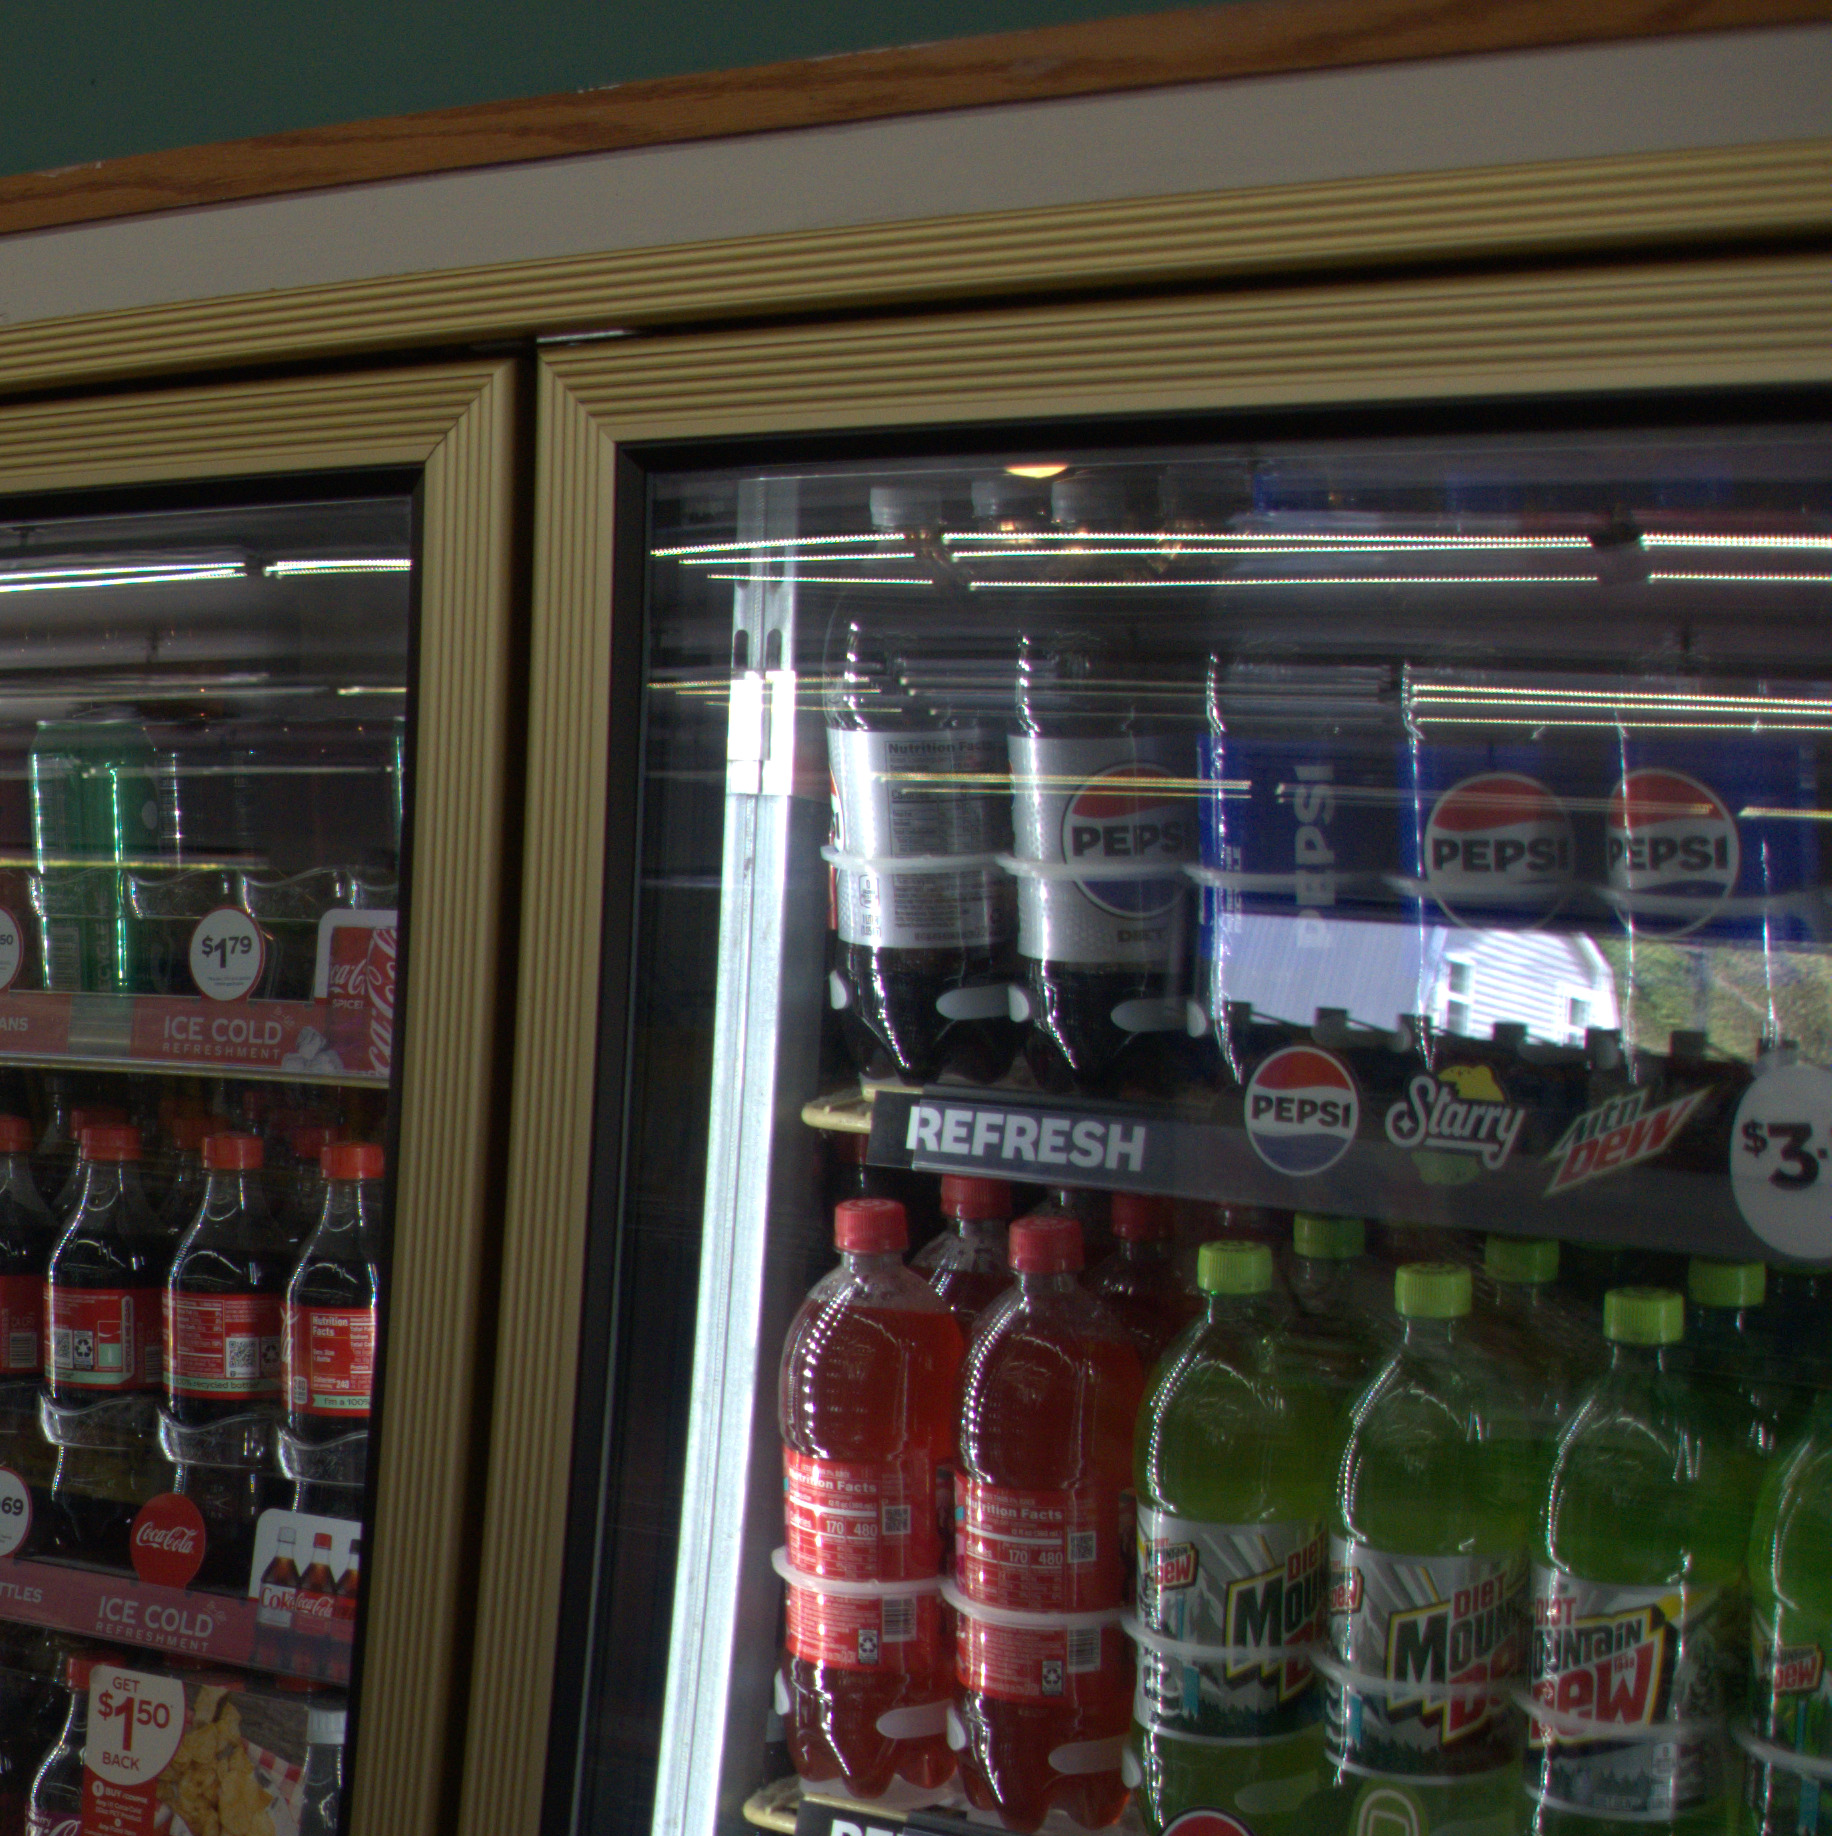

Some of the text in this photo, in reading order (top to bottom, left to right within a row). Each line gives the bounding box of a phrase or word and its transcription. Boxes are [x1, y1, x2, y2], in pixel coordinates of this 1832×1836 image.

[1433, 836, 1570, 872] PEPSI
[201, 935, 253, 969] $179
[163, 1015, 282, 1046] ICE COLD
[163, 1042, 280, 1060] REFRESHMENT
[1252, 1096, 1352, 1129] PEPSI
[1386, 1075, 1526, 1171] Starry
[907, 1102, 1145, 1172] REFRESH
[837, 1481, 877, 1494] Facts
[136, 1521, 198, 1554] Coca-Cola
[826, 1520, 878, 1537] 170 480
[1008, 1549, 1063, 1565] 170 480
[98, 1595, 214, 1638] ICE COLD
[95, 1621, 209, 1652] REFRESHMENT
[112, 1676, 140, 1693] GET
[102, 1751, 140, 1771] BACK
